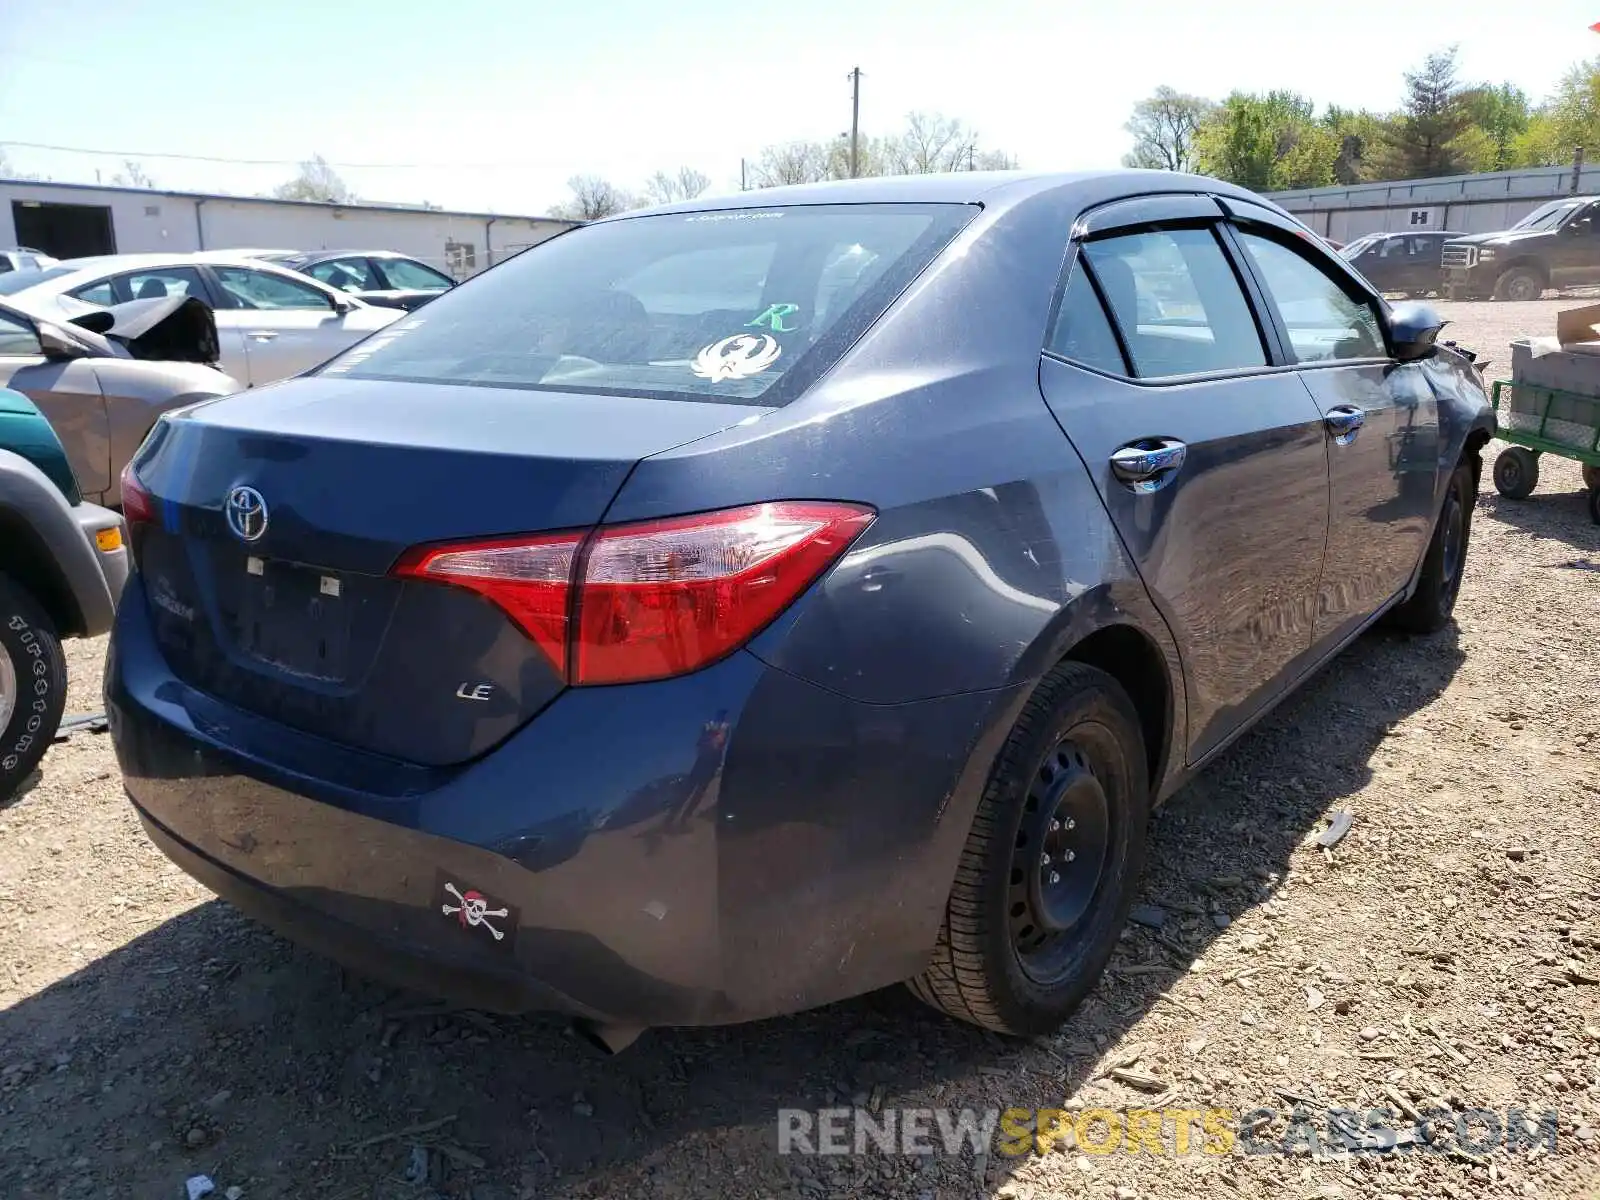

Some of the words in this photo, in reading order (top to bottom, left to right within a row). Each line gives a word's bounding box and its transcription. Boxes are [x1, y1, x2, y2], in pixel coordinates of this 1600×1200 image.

[1410, 211, 1428, 225] H
[743, 303, 799, 332] R
[2, 615, 48, 770] Firestone
[456, 681, 492, 701] LE
